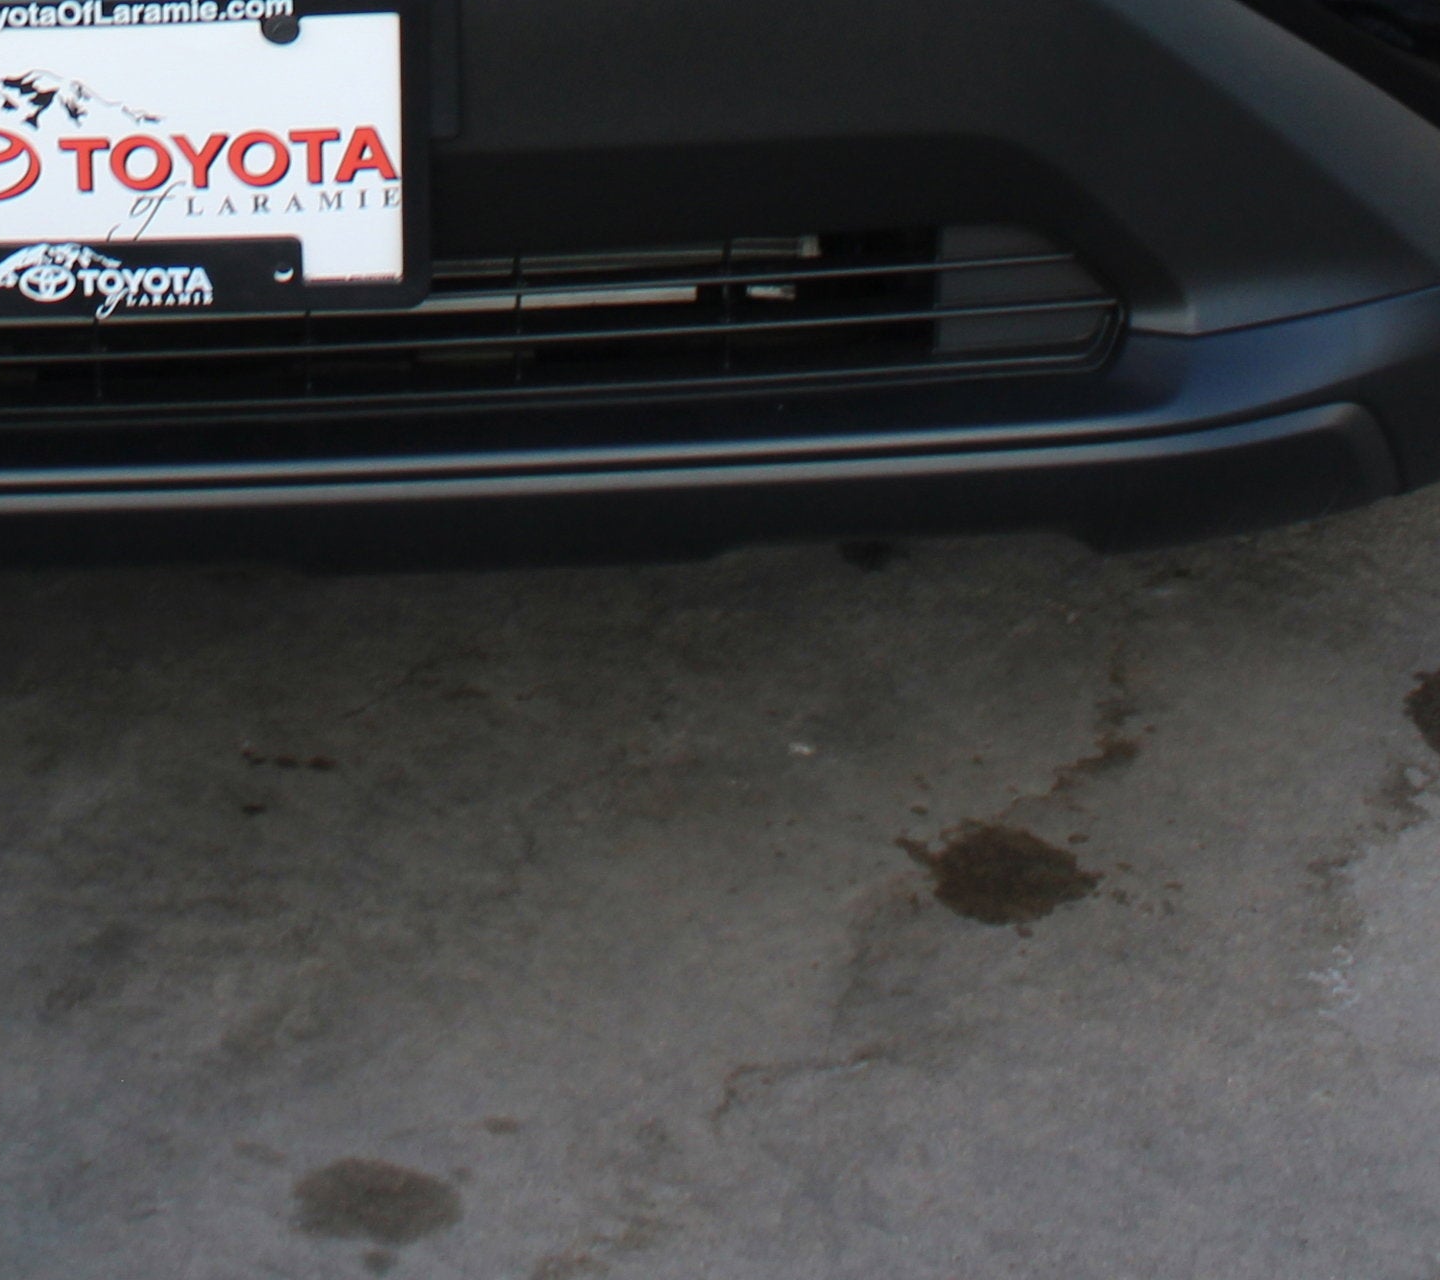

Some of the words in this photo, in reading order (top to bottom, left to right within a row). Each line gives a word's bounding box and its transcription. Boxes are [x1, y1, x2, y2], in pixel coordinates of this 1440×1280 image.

[58, 124, 400, 193] TOYOTA
[106, 181, 186, 242] of
[186, 188, 402, 217] LARAMIE
[77, 266, 214, 297] TOYOTA
